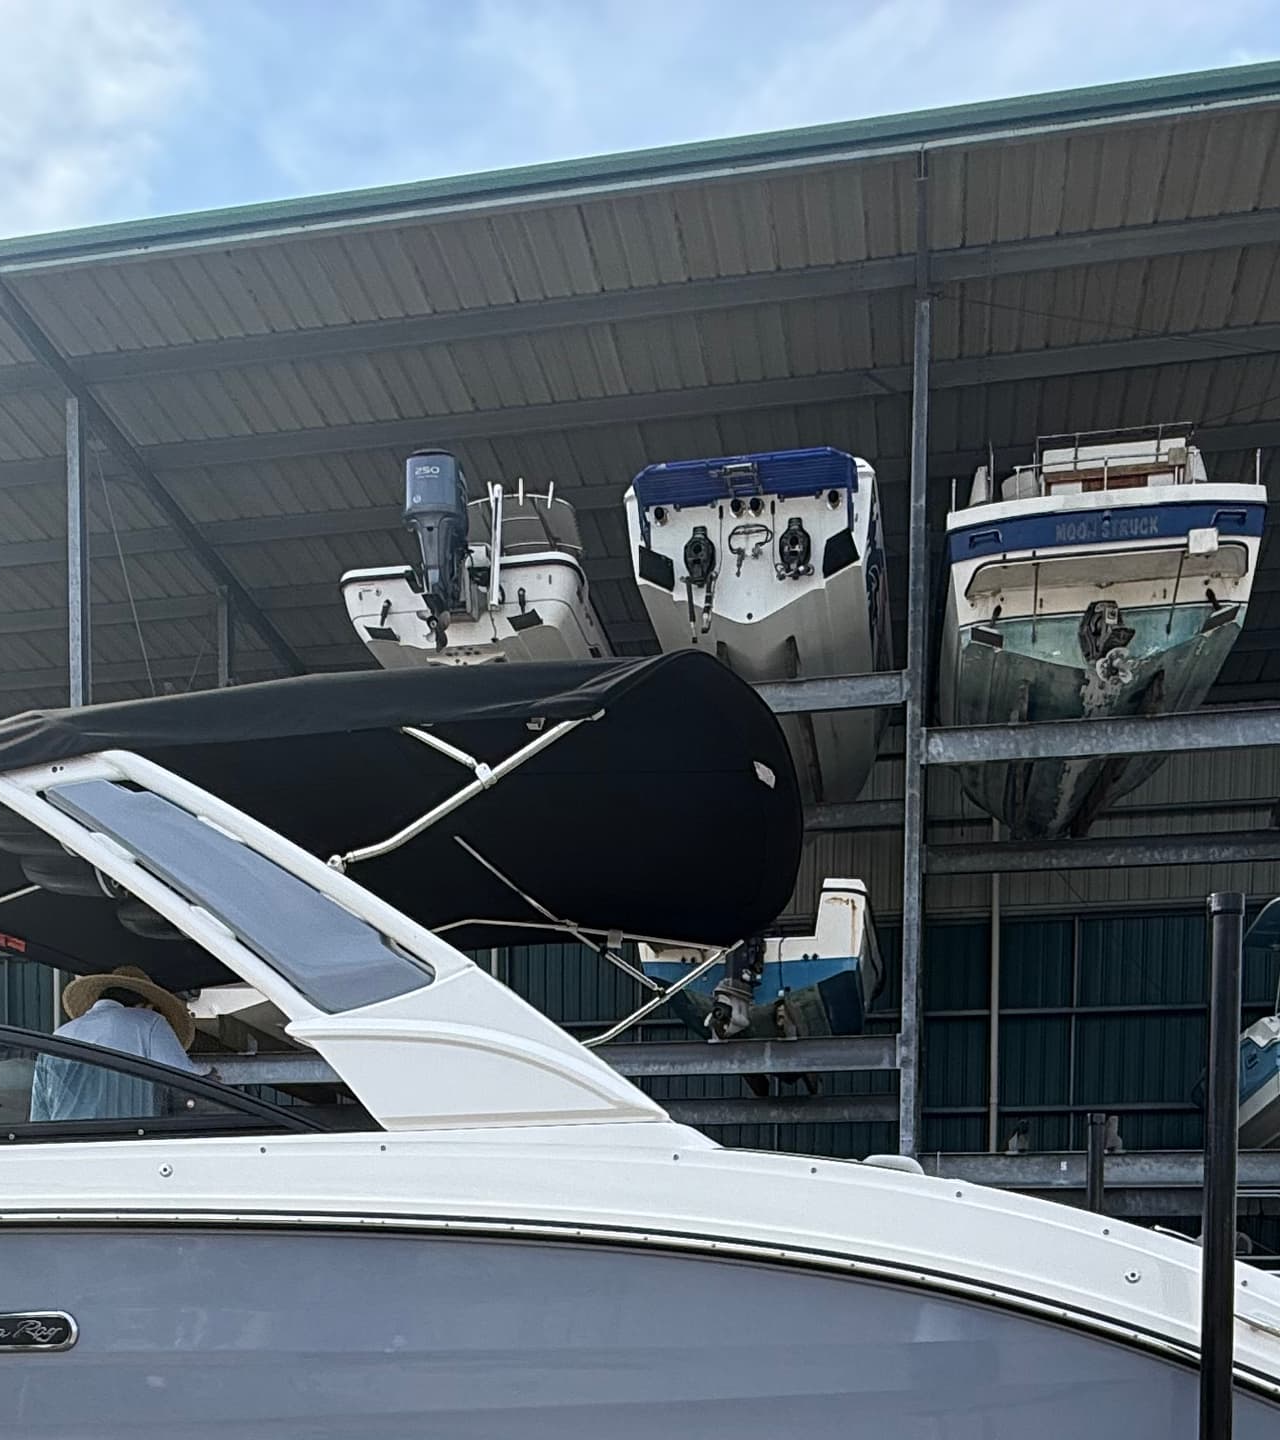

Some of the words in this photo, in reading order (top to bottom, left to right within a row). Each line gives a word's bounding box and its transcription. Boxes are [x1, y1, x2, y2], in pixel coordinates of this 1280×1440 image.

[415, 466, 440, 475] 250
[1101, 515, 1159, 538] STRUCK
[11, 1319, 63, 1343] Ray
